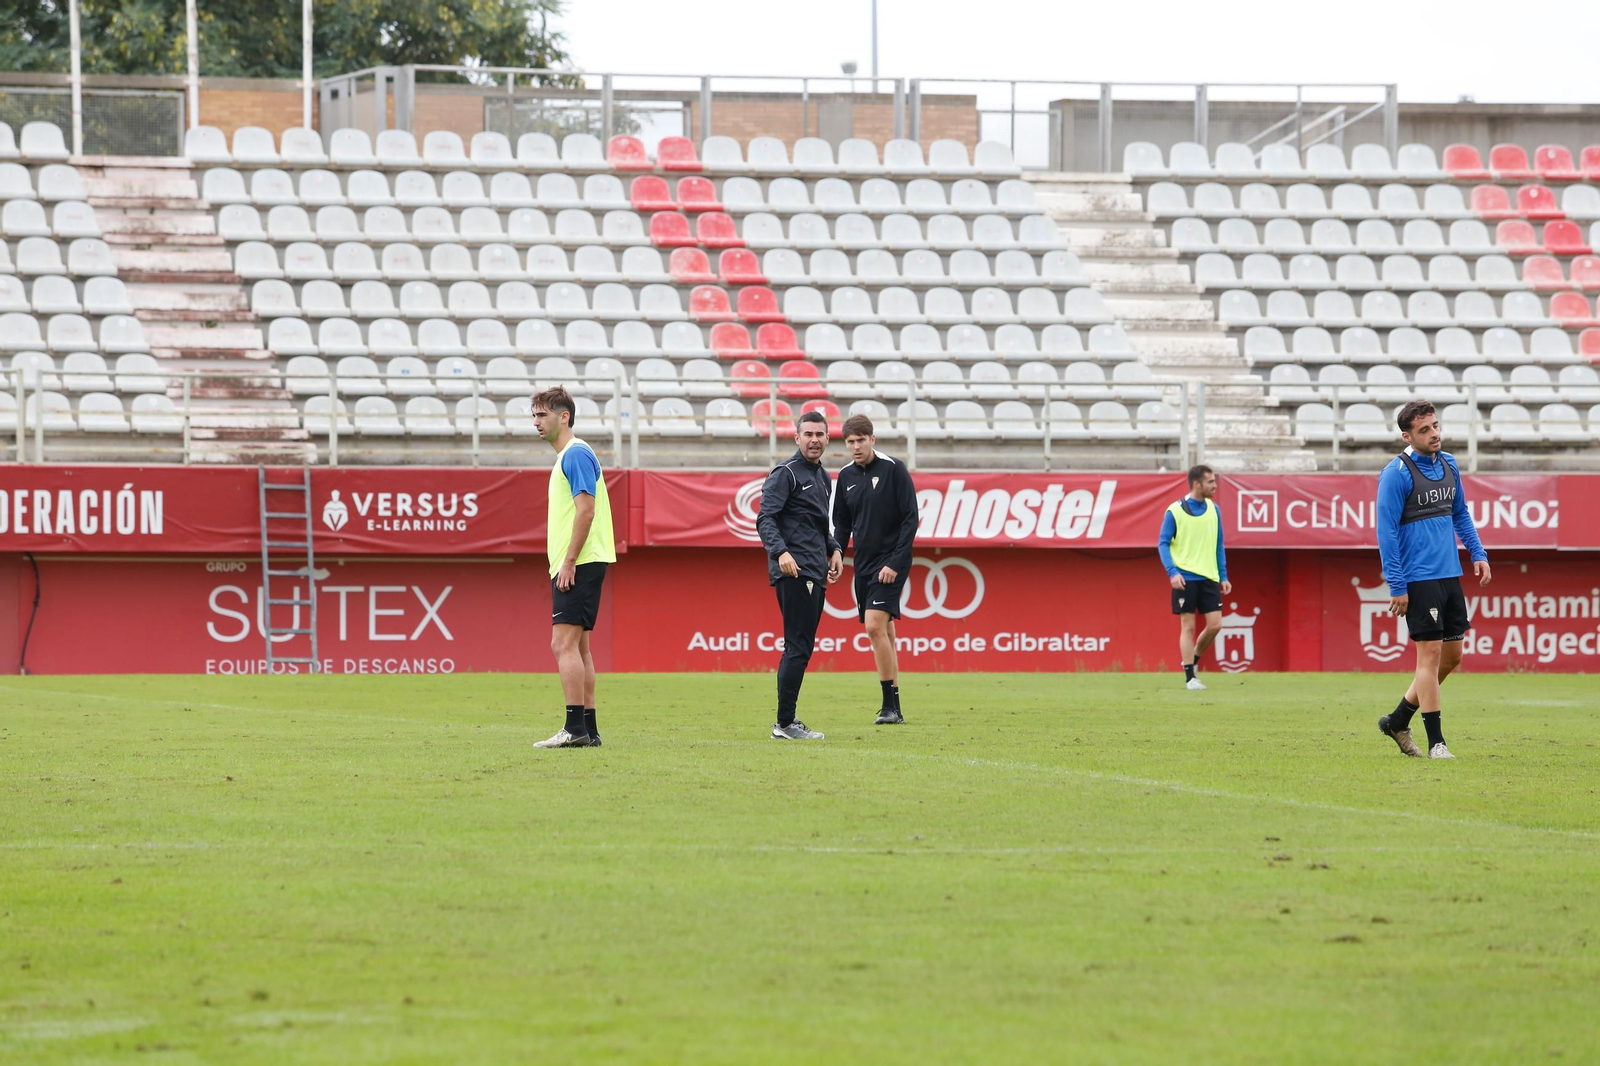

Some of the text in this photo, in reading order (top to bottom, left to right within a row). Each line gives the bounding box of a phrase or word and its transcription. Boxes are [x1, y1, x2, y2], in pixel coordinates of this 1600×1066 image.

[352, 492, 479, 517] VERSUS
[1285, 494, 1559, 529] CLÍNI UÑOZ
[367, 519, 467, 532] E-LEARNING
[206, 562, 247, 573] GRUPO
[206, 584, 454, 643] SUTEX
[1464, 587, 1600, 622] yuntami
[687, 631, 1110, 656] Audi Ceter Cmpo de Gibraltar
[1462, 628, 1494, 656] de
[205, 658, 456, 675] EQUIPOS DE DESCANSO
